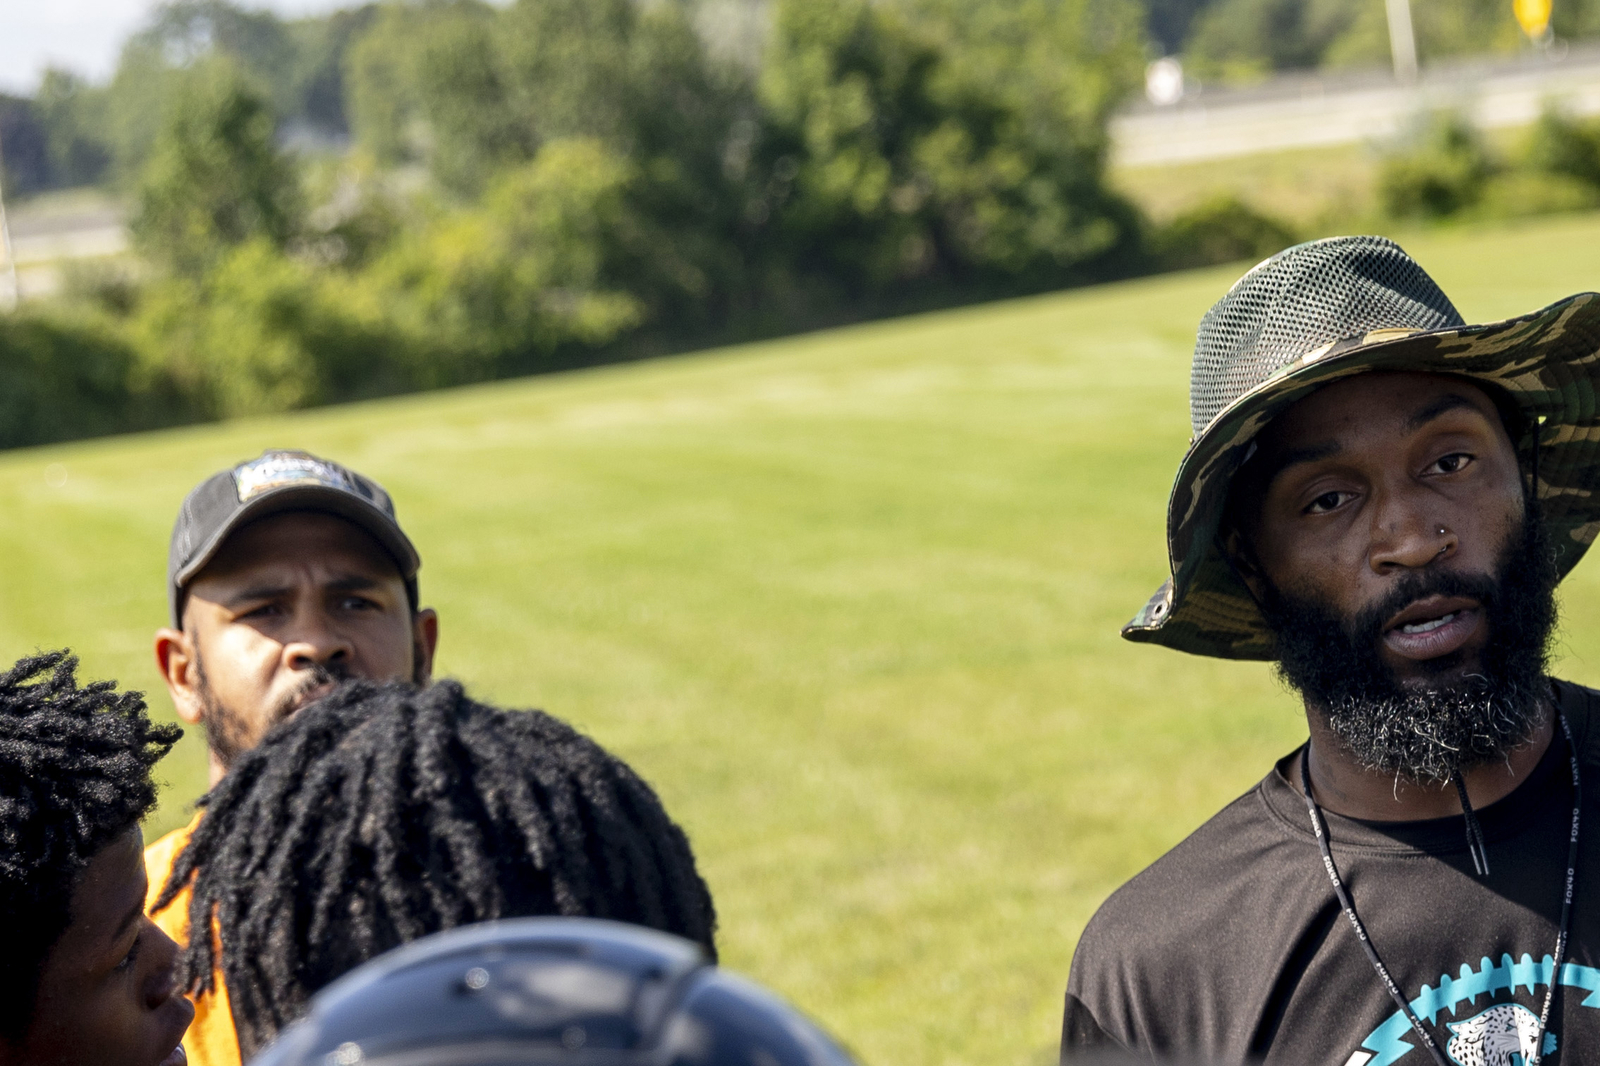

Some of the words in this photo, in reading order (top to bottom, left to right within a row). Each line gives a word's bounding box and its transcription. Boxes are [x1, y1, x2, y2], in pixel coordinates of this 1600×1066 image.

[1570, 807, 1580, 843] FOX40
[1322, 855, 1341, 888] FOX40
[1565, 867, 1575, 905] FOX40
[1538, 990, 1553, 1030] FOX40
